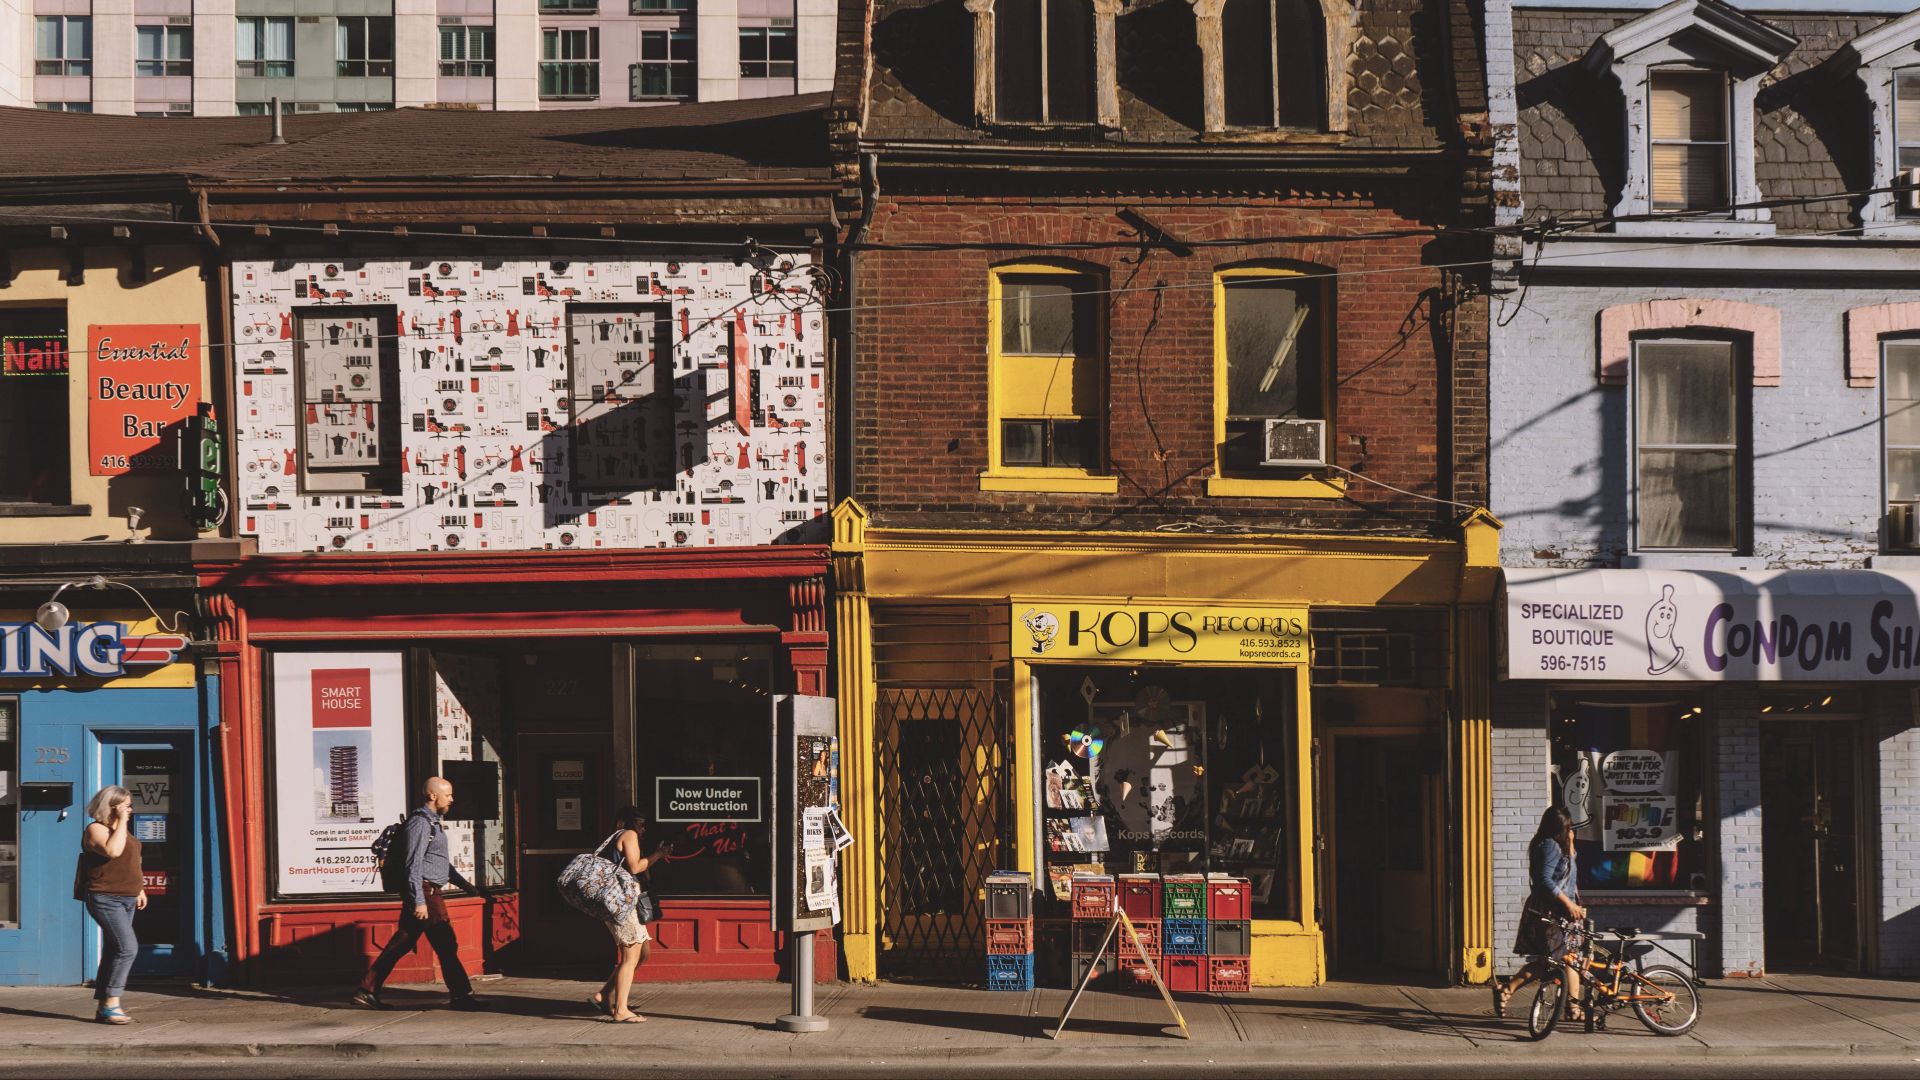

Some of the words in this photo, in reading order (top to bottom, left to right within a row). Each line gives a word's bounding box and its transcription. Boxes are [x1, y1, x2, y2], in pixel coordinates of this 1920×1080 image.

[97, 338, 190, 361] Essential
[99, 377, 190, 408] Beauty
[123, 415, 167, 438] Bar
[1521, 604, 1624, 620] SPECIALIZED
[1068, 610, 1197, 654] KOPS
[1203, 616, 1302, 638] RECORDS
[1239, 639, 1301, 649] 416.593.8523
[1532, 629, 1614, 646] BOUTIQUE
[1239, 649, 1301, 659] kopsrecords.ca
[1540, 655, 1607, 671] 596-7515
[321, 686, 361, 698] SMART
[322, 698, 362, 710] HOUSE
[35, 747, 70, 764] 225
[1607, 761, 1630, 770] TUNE
[1632, 761, 1642, 770] IN
[1643, 761, 1661, 770] FOR
[554, 770, 582, 778] CLOSED
[1626, 771, 1640, 779] THE
[136, 783, 167, 804] W
[675, 788, 701, 798] Now
[705, 787, 742, 798] Under
[669, 801, 748, 811] Construction
[687, 815, 738, 839] That's
[1616, 827, 1662, 839] 103.9
[1118, 829, 1149, 842] Kops
[315, 855, 377, 864] 416.292.0219
